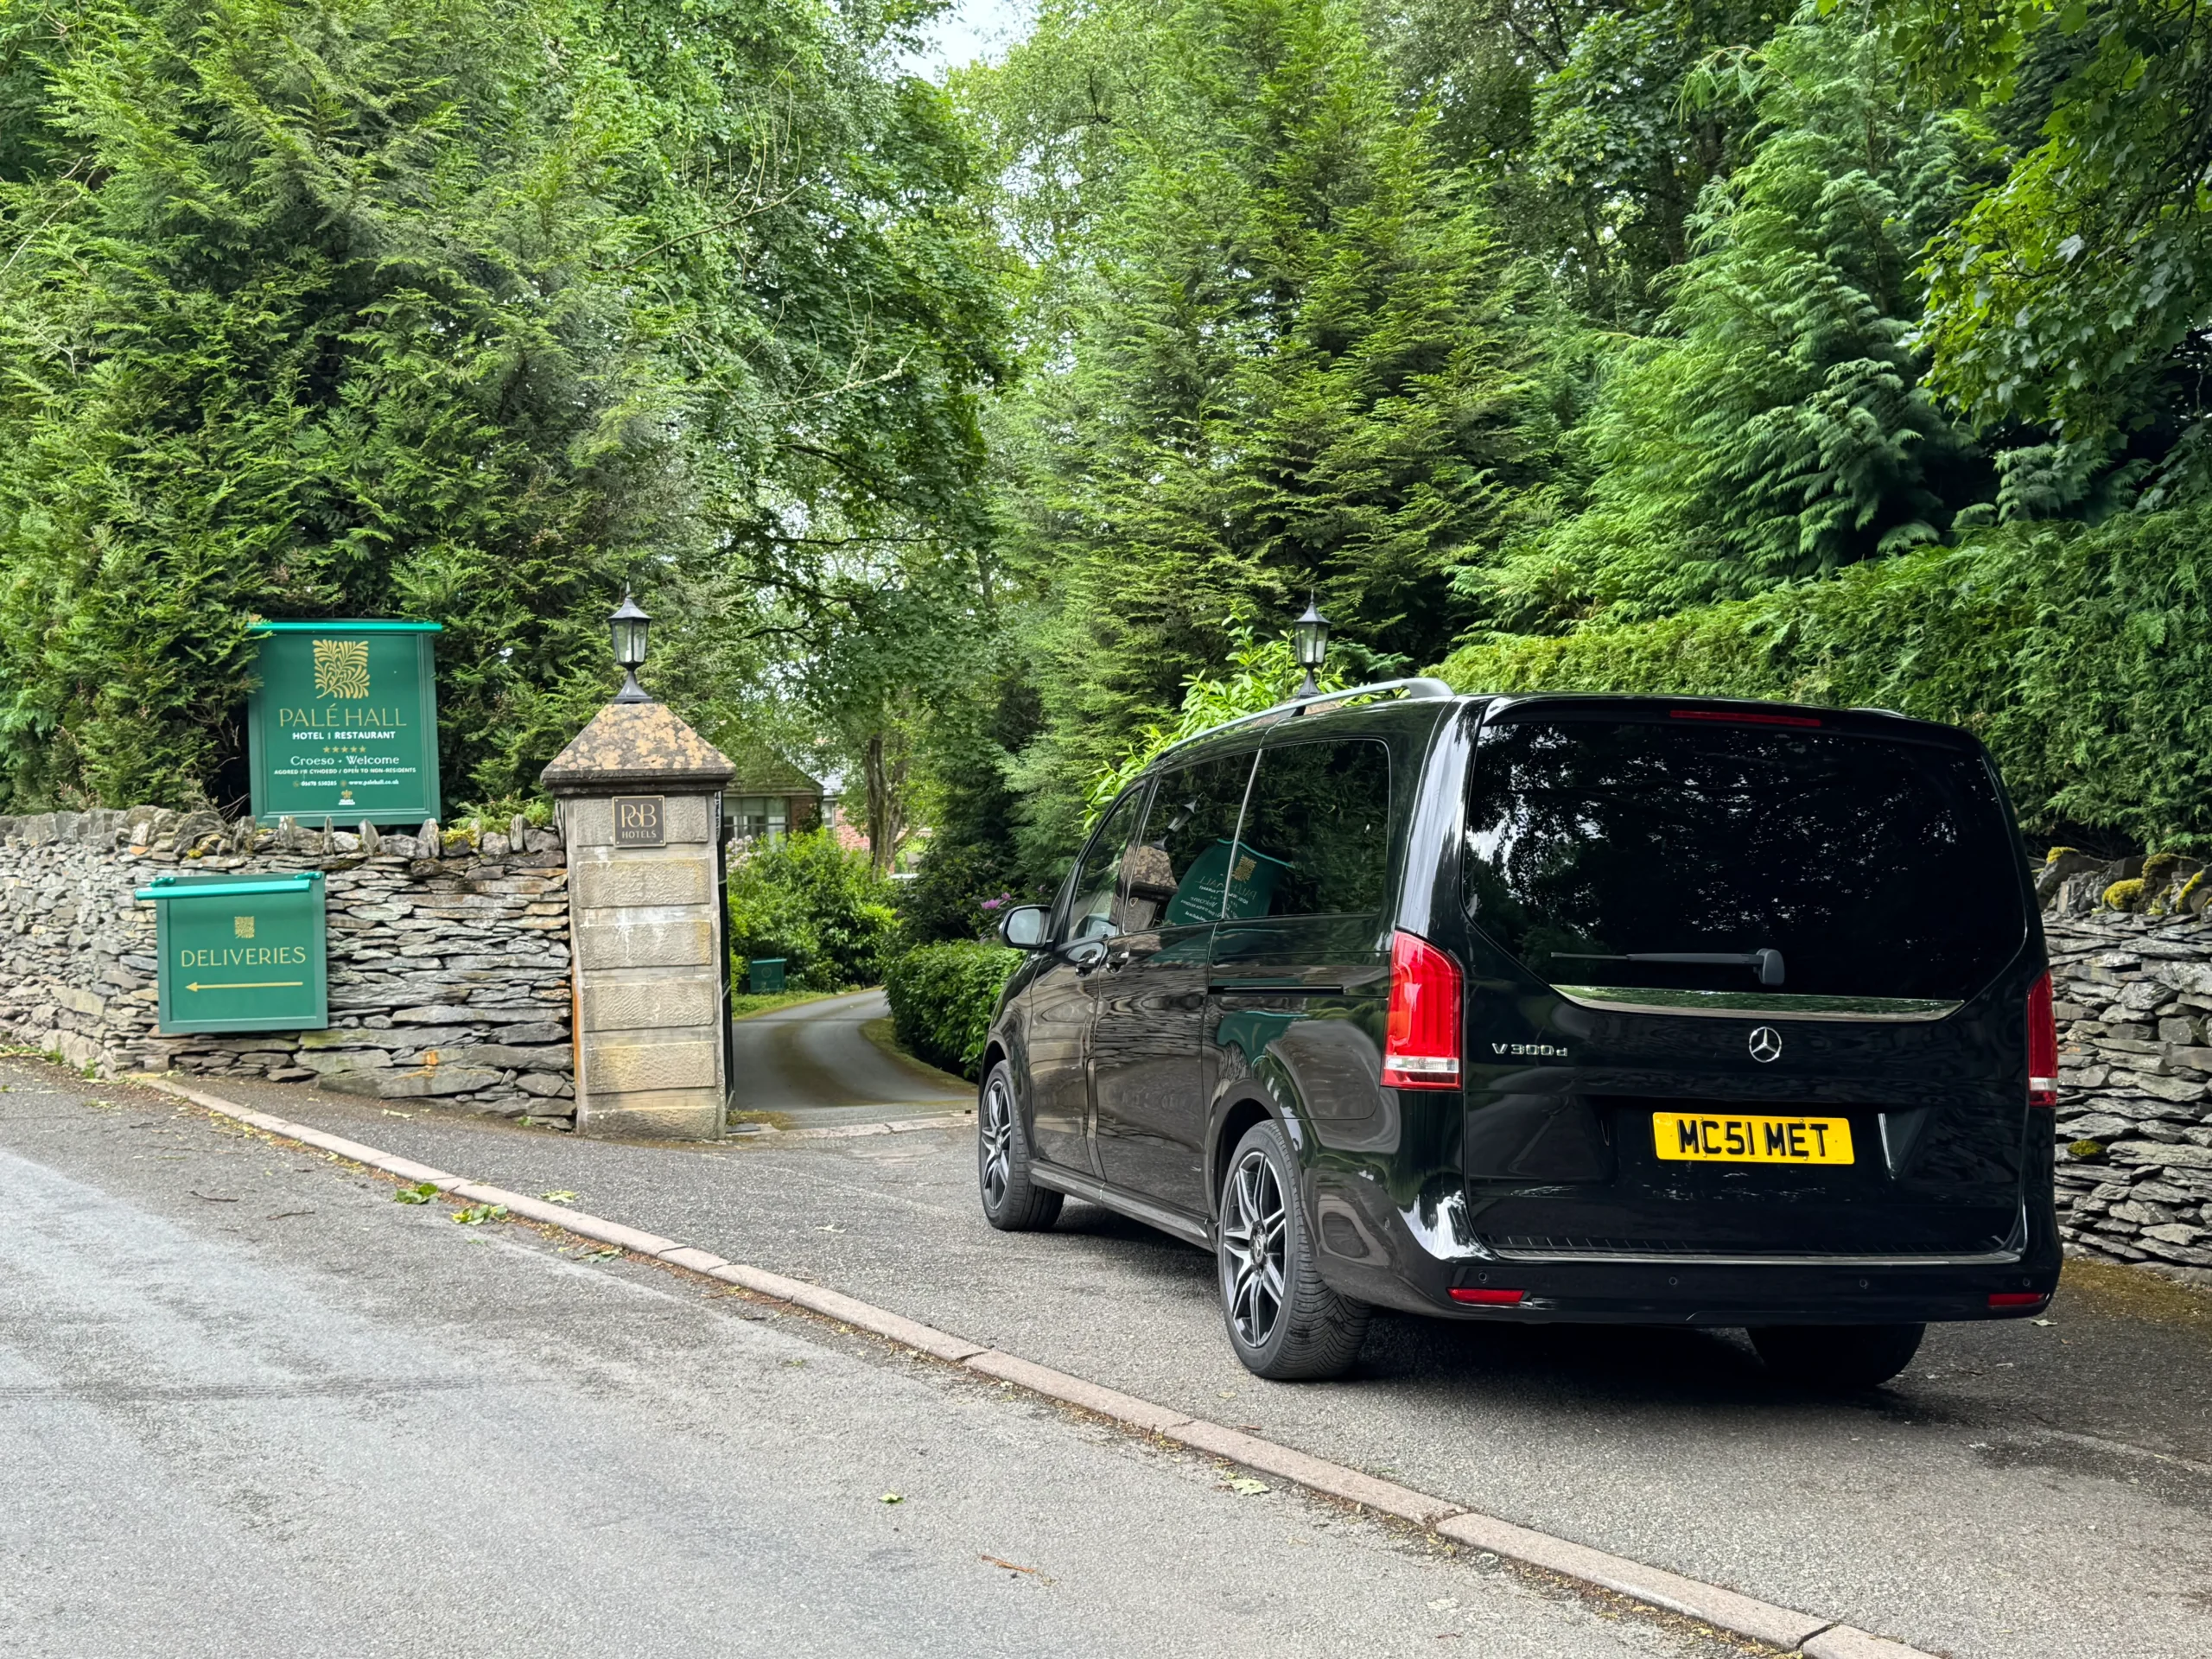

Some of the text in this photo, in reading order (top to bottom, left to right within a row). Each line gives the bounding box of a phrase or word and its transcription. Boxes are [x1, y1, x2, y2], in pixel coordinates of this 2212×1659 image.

[279, 702, 407, 728] PALÉ HALL
[292, 732, 325, 741] HOTEL
[334, 731, 396, 740] RESTAURANT
[290, 755, 334, 766] Croeso
[346, 754, 400, 766] Welcome
[622, 830, 657, 838] HOTELS
[181, 946, 306, 967] DELIVERIES
[1677, 1119, 1828, 1157] MC51 MET
